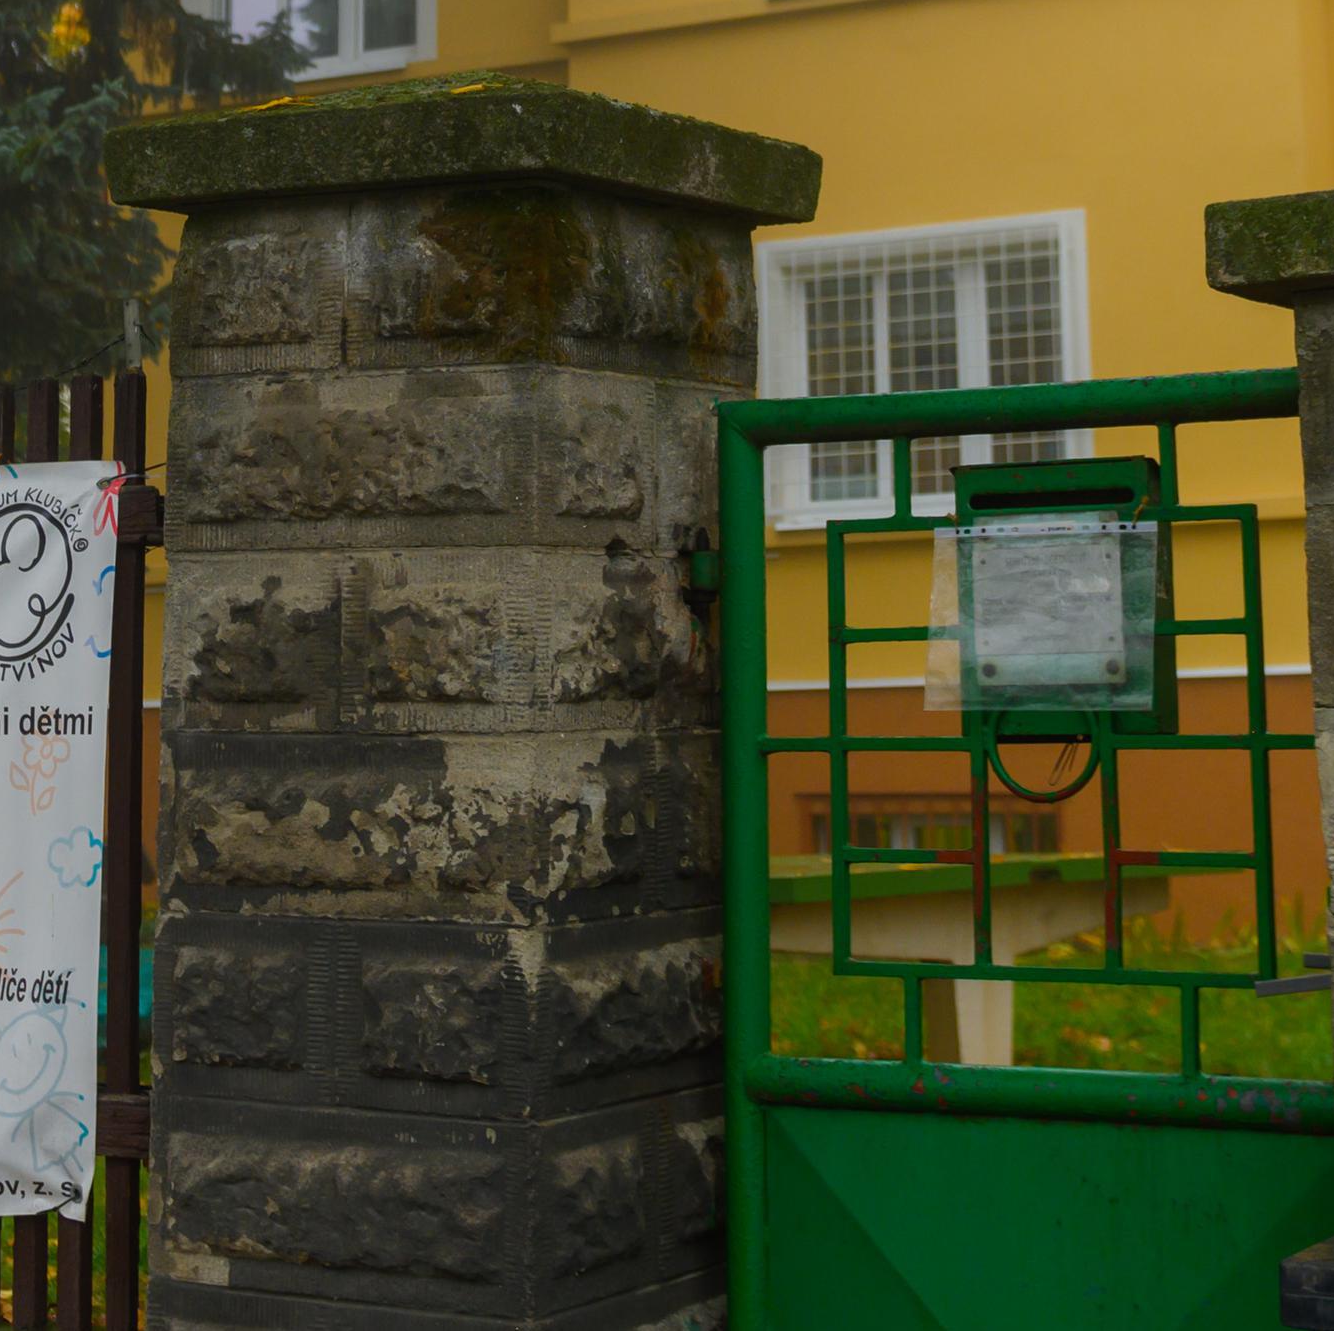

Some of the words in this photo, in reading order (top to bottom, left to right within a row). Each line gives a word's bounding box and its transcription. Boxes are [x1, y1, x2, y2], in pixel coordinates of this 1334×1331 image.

[19, 705, 94, 736] dětmi
[30, 970, 73, 1005] dětí
[32, 1181, 54, 1197] z.
